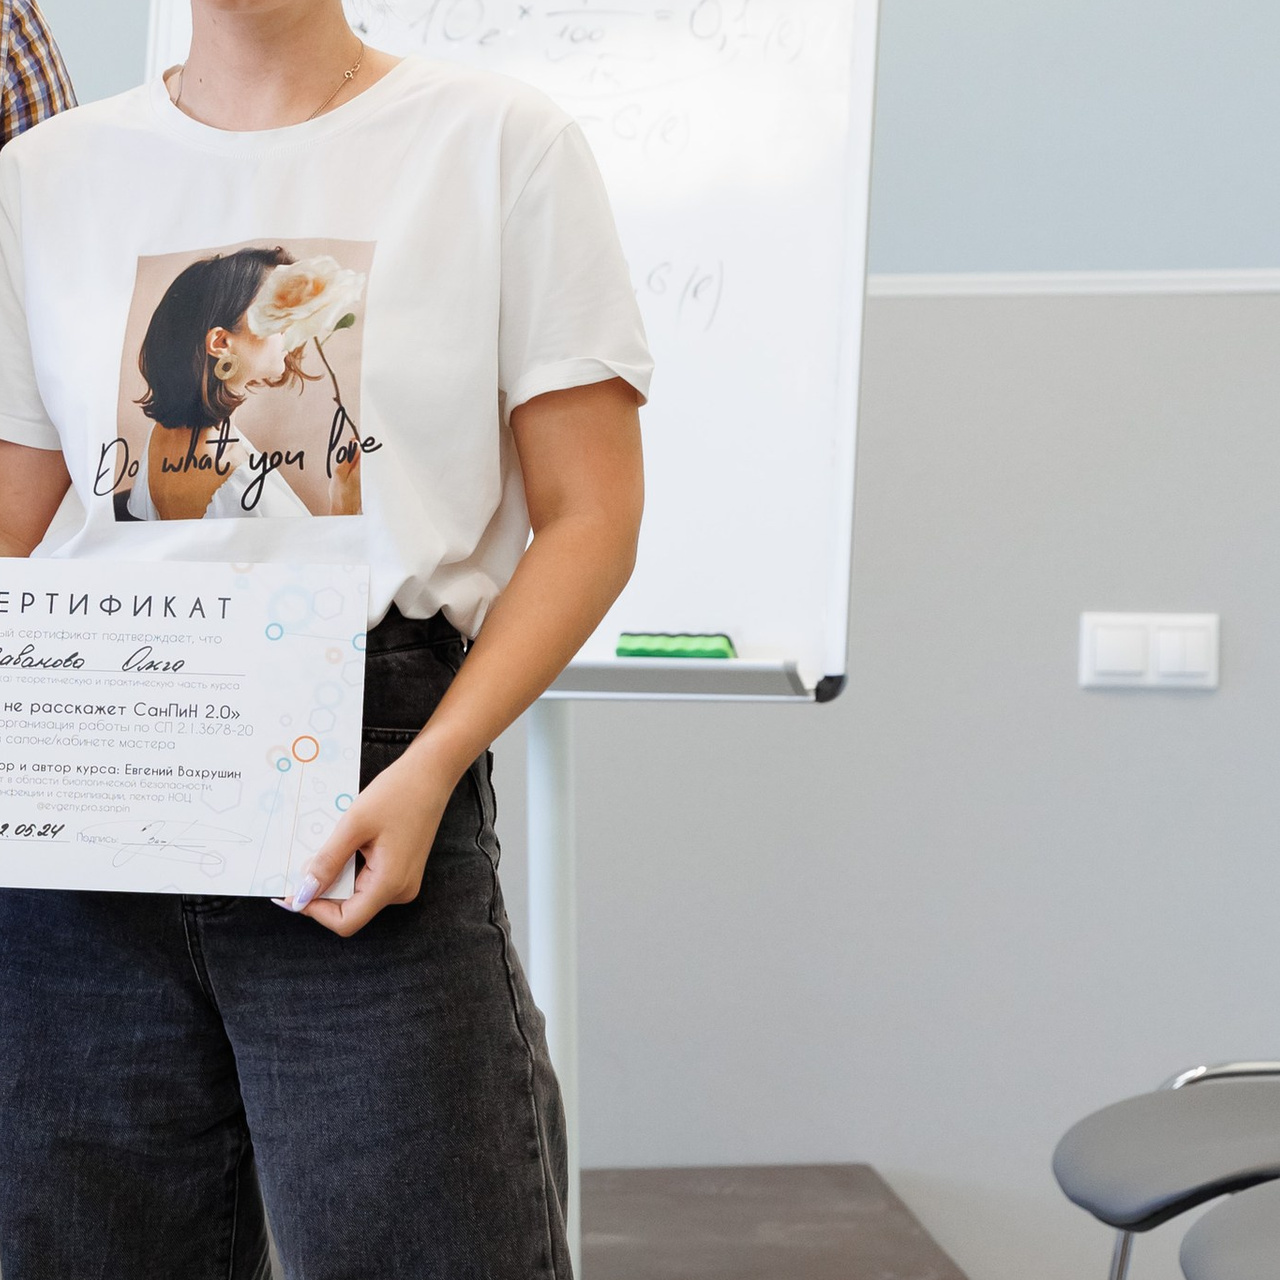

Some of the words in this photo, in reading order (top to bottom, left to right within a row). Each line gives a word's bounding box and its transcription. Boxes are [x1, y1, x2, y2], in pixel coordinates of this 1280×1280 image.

[93, 437, 139, 497] Do
[161, 416, 240, 477] what
[240, 447, 305, 511] you
[326, 406, 383, 479] love
[18, 629, 98, 641] сертификат
[102, 631, 195, 644] подтверждает,
[199, 635, 223, 645] что
[16, 676, 92, 686] теоретическую
[104, 679, 175, 690] практическую
[178, 681, 208, 689] часть
[210, 682, 240, 691] курса
[4, 701, 23, 712] не
[30, 701, 127, 716] расскажет
[133, 700, 198, 718] СанПиН
[205, 704, 241, 720] 2.0»
[78, 719, 129, 733] работы
[133, 722, 150, 732] по
[154, 721, 173, 733] СП
[177, 722, 254, 737] 2.1.3678-20
[6, 734, 115, 747] салоне/кабинете
[118, 739, 176, 752] мастера
[20, 762, 27, 771] и
[32, 763, 72, 775] автор
[76, 765, 120, 777] курса:
[125, 763, 173, 776] Евгений
[178, 766, 242, 780] Вахрушин
[15, 774, 59, 785] области
[62, 776, 137, 788] биологической
[140, 780, 213, 792] безопасности,
[36, 802, 131, 813] @evgeny.pro.sanpin
[129, 794, 166, 803] лектор
[168, 793, 192, 804] НОЦ
[76, 831, 119, 844] Подпись:
